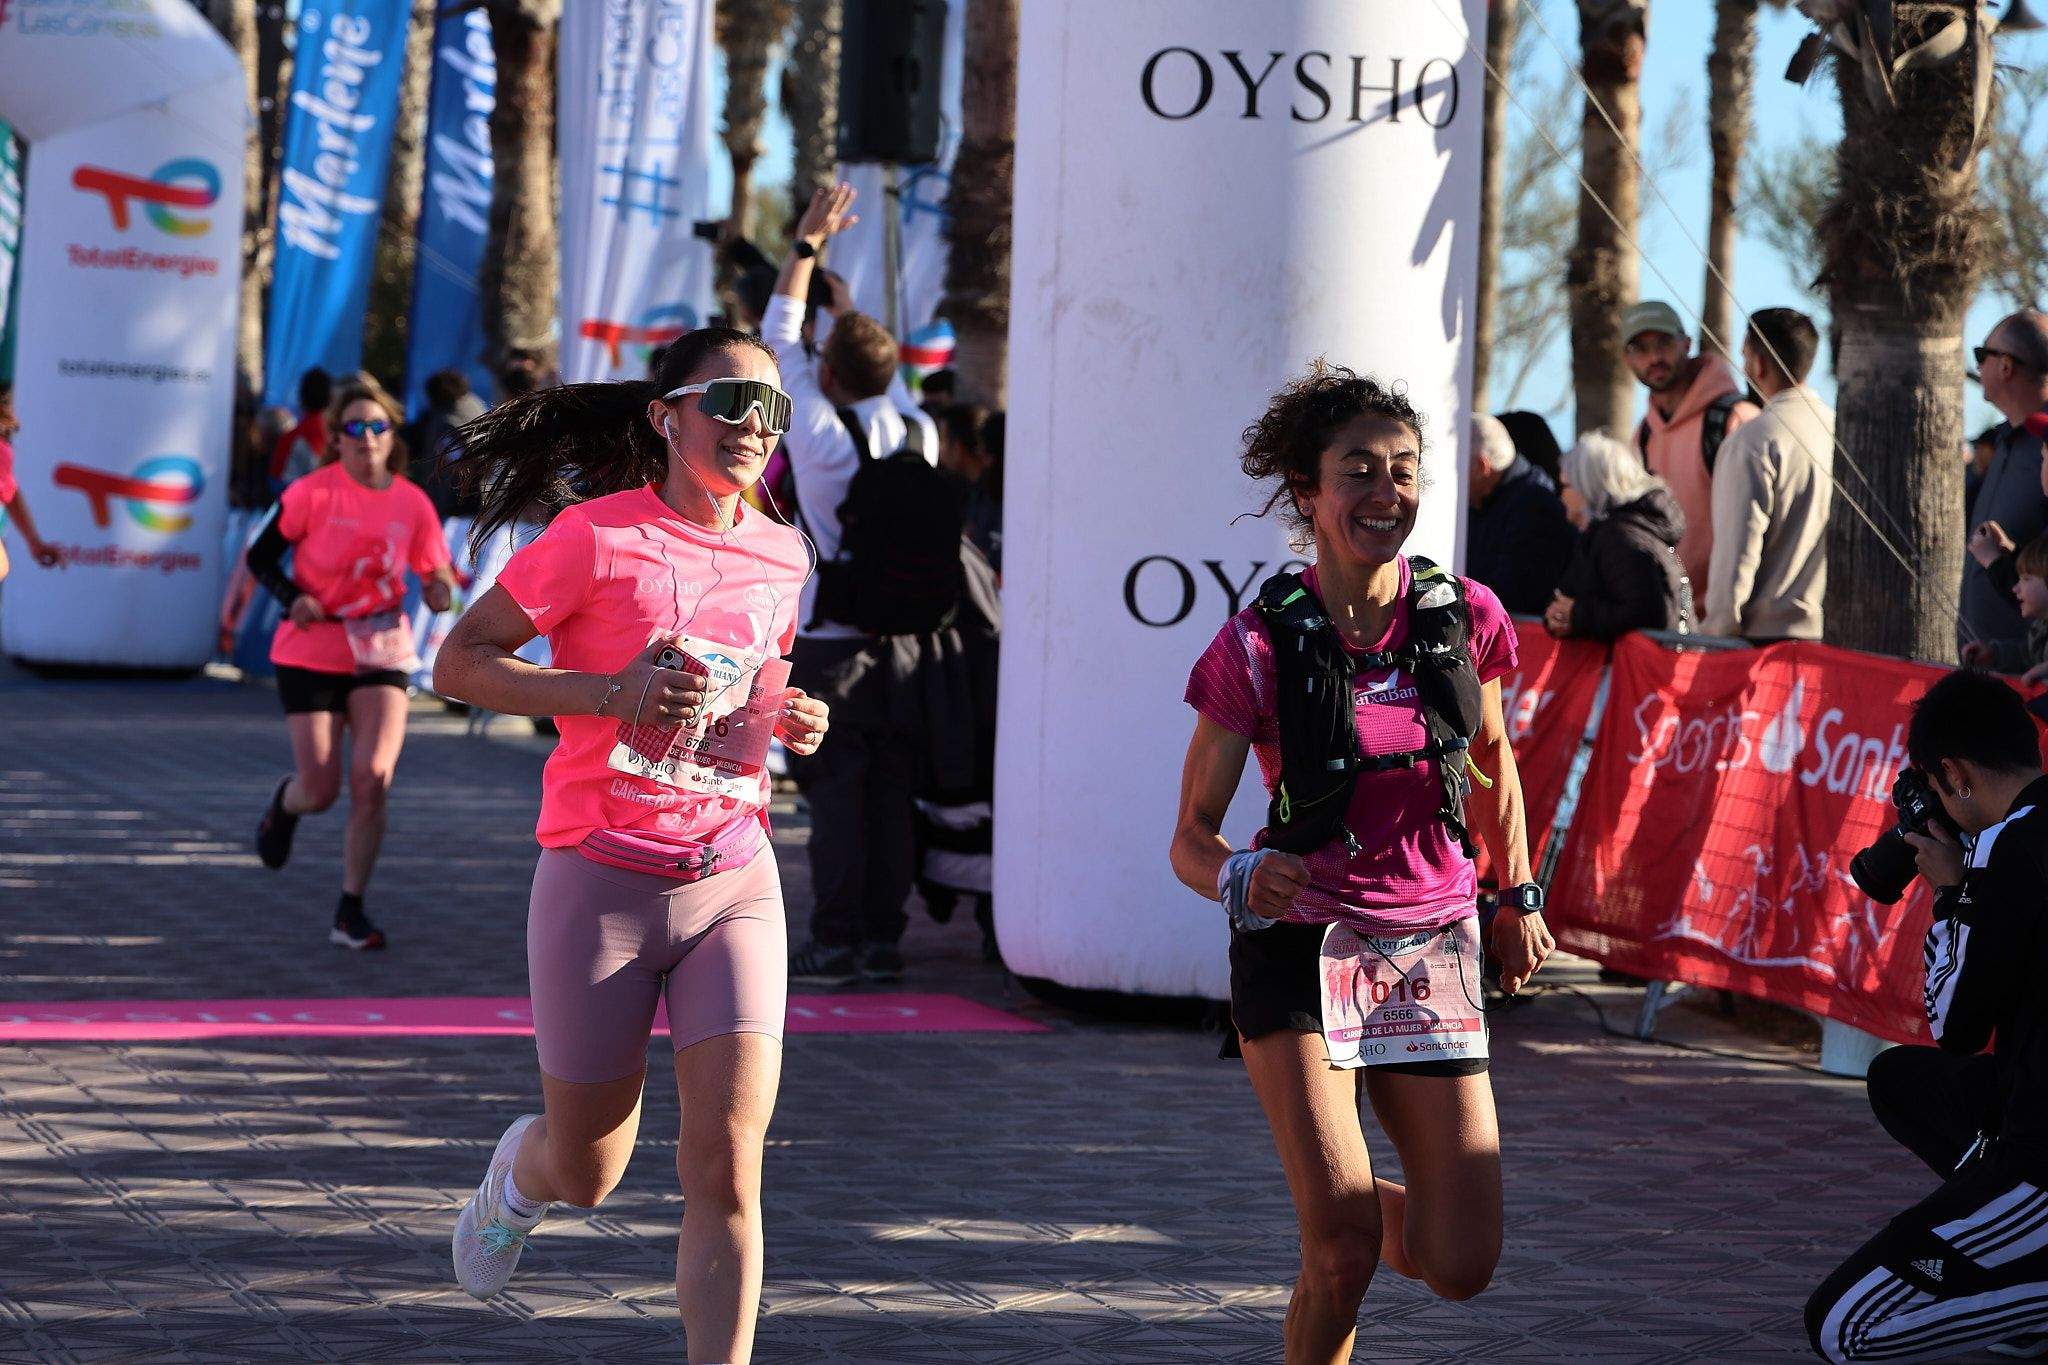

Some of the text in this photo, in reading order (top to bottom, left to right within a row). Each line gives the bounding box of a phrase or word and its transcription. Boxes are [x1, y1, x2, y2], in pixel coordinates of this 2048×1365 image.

[1140, 46, 1458, 129] OYSHO
[66, 244, 219, 278] TotalEnergies
[46, 541, 202, 576] otalEnergies
[639, 578, 702, 596] OYSHO
[1123, 555, 1310, 627] OY
[1354, 686, 1419, 706] aixaBan
[1627, 692, 1760, 788] Sports
[1800, 707, 1911, 804] Sant
[1370, 977, 1431, 1004] 016
[1383, 1009, 1413, 1021] 6566
[1372, 1027, 1382, 1035] DE
[1384, 1026, 1394, 1034] LA
[1396, 1024, 1422, 1033] MUJER
[1419, 1039, 1469, 1051] Santander
[1910, 1260, 1943, 1281] adidas
